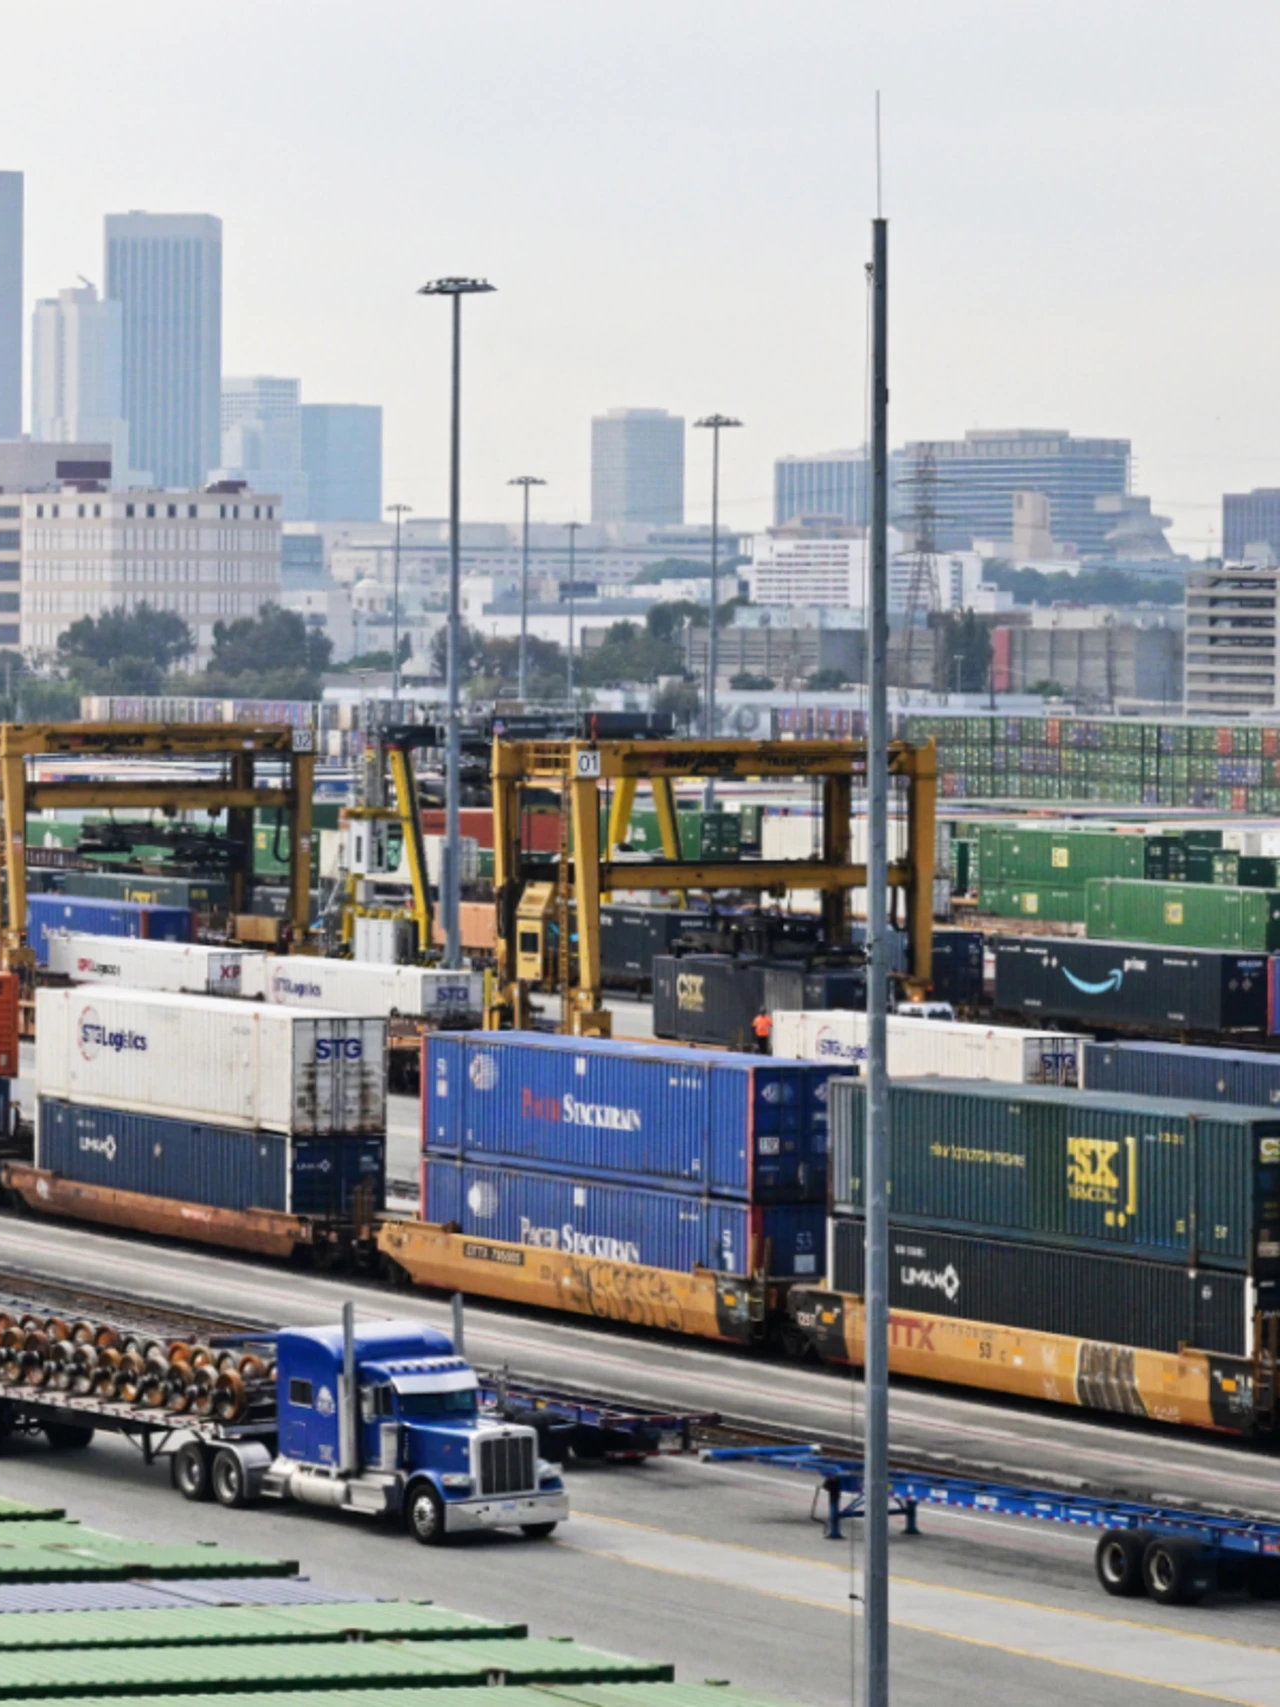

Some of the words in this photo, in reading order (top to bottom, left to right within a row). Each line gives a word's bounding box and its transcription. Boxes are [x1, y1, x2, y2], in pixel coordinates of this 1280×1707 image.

[294, 731, 311, 747] 02
[577, 753, 598, 773] 01
[315, 1038, 362, 1060] STG
